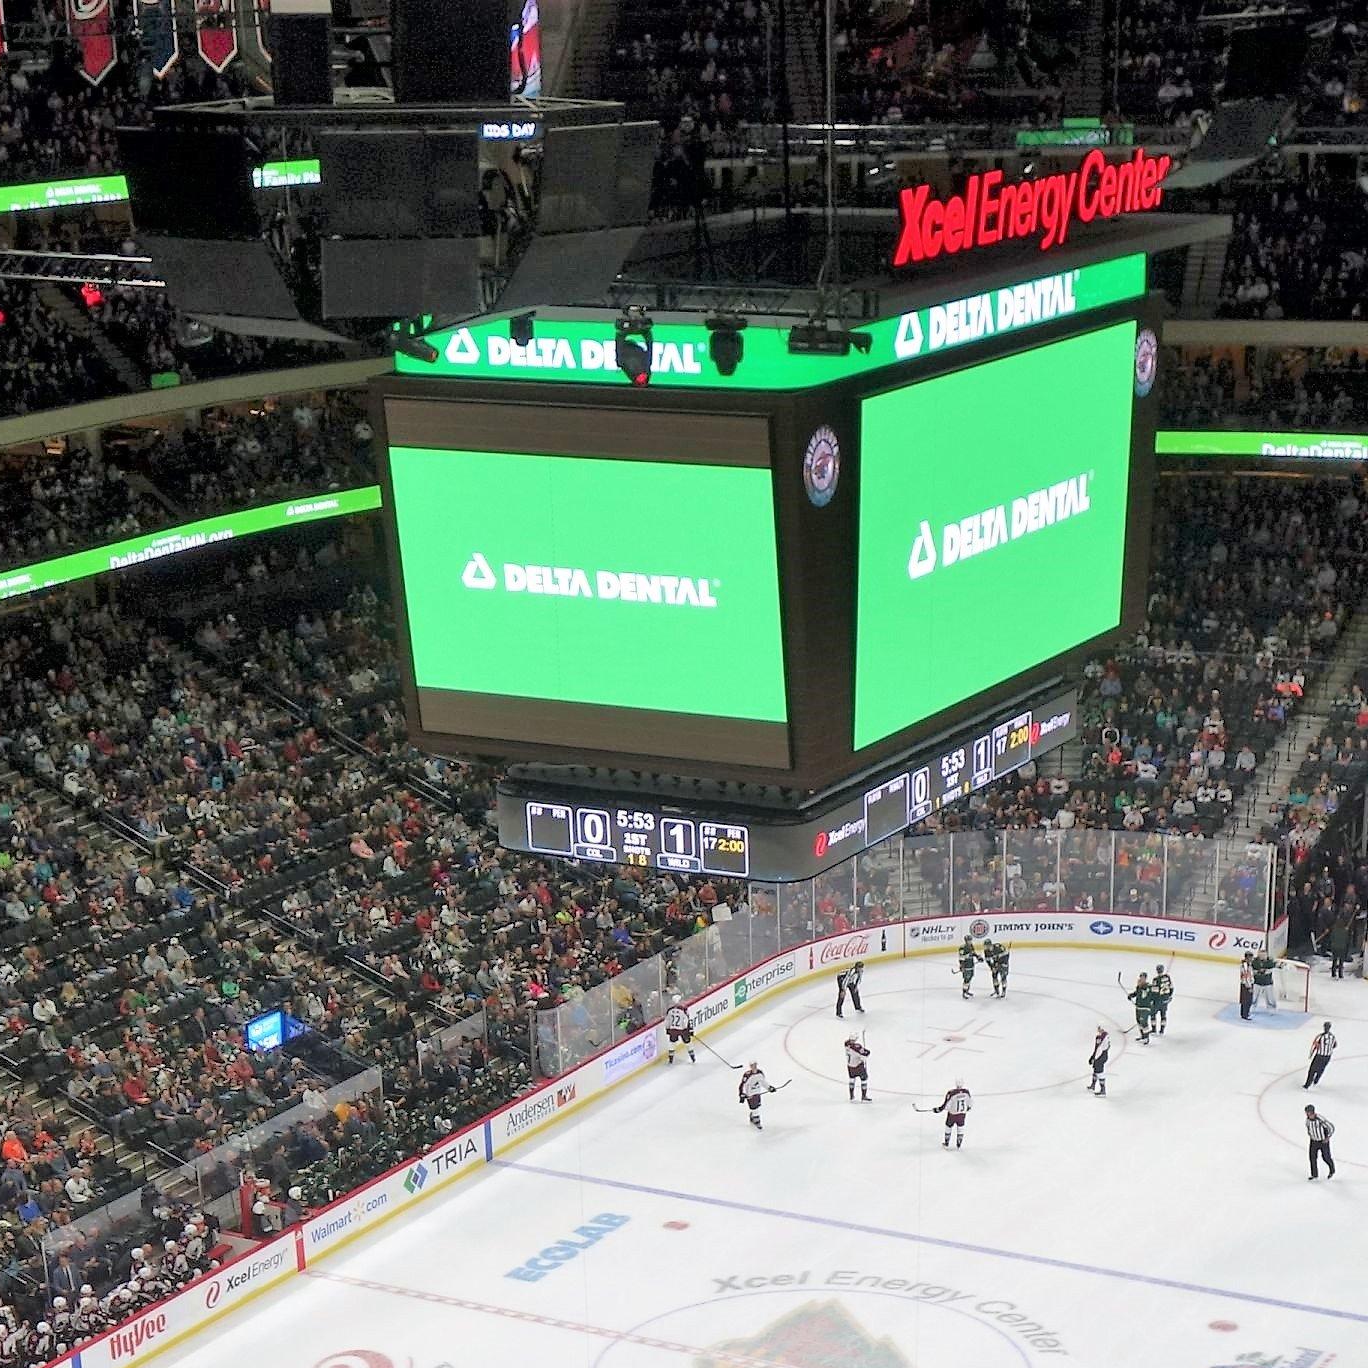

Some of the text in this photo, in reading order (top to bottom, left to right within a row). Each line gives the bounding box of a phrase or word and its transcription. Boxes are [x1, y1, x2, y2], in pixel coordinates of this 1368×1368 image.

[512, 122, 535, 137] DAY
[1079, 148, 1171, 223] Center
[929, 275, 1077, 350] DELTA DENTAL
[487, 336, 701, 373] DELTA DETAL
[942, 473, 1090, 567] DELTA DENTAL
[504, 563, 717, 607] DELTA DENTAL
[978, 742, 985, 769] 1
[996, 738, 1007, 756] 17
[1010, 726, 1028, 749] 2:00
[941, 748, 965, 777] 5:53
[916, 774, 925, 802] 0
[584, 813, 604, 844] 0
[616, 810, 655, 831] 5:53
[623, 833, 648, 846] 1ST
[670, 824, 685, 854] 1
[704, 837, 744, 853] 17 2:00
[993, 922, 1074, 933] JIMMY JOHN'S
[1119, 924, 1196, 942] POLARIS
[1233, 936, 1263, 950] Xcel
[736, 960, 794, 998] enterprise
[689, 998, 729, 1030] arTribune
[507, 1093, 555, 1128] Andersen
[432, 1138, 478, 1175] TRIA
[311, 1192, 387, 1243] Walmart com
[504, 1213, 631, 1281] ECOLAB
[712, 1270, 1069, 1355] Xcel Energy Center
[110, 1313, 166, 1360] HyVee
